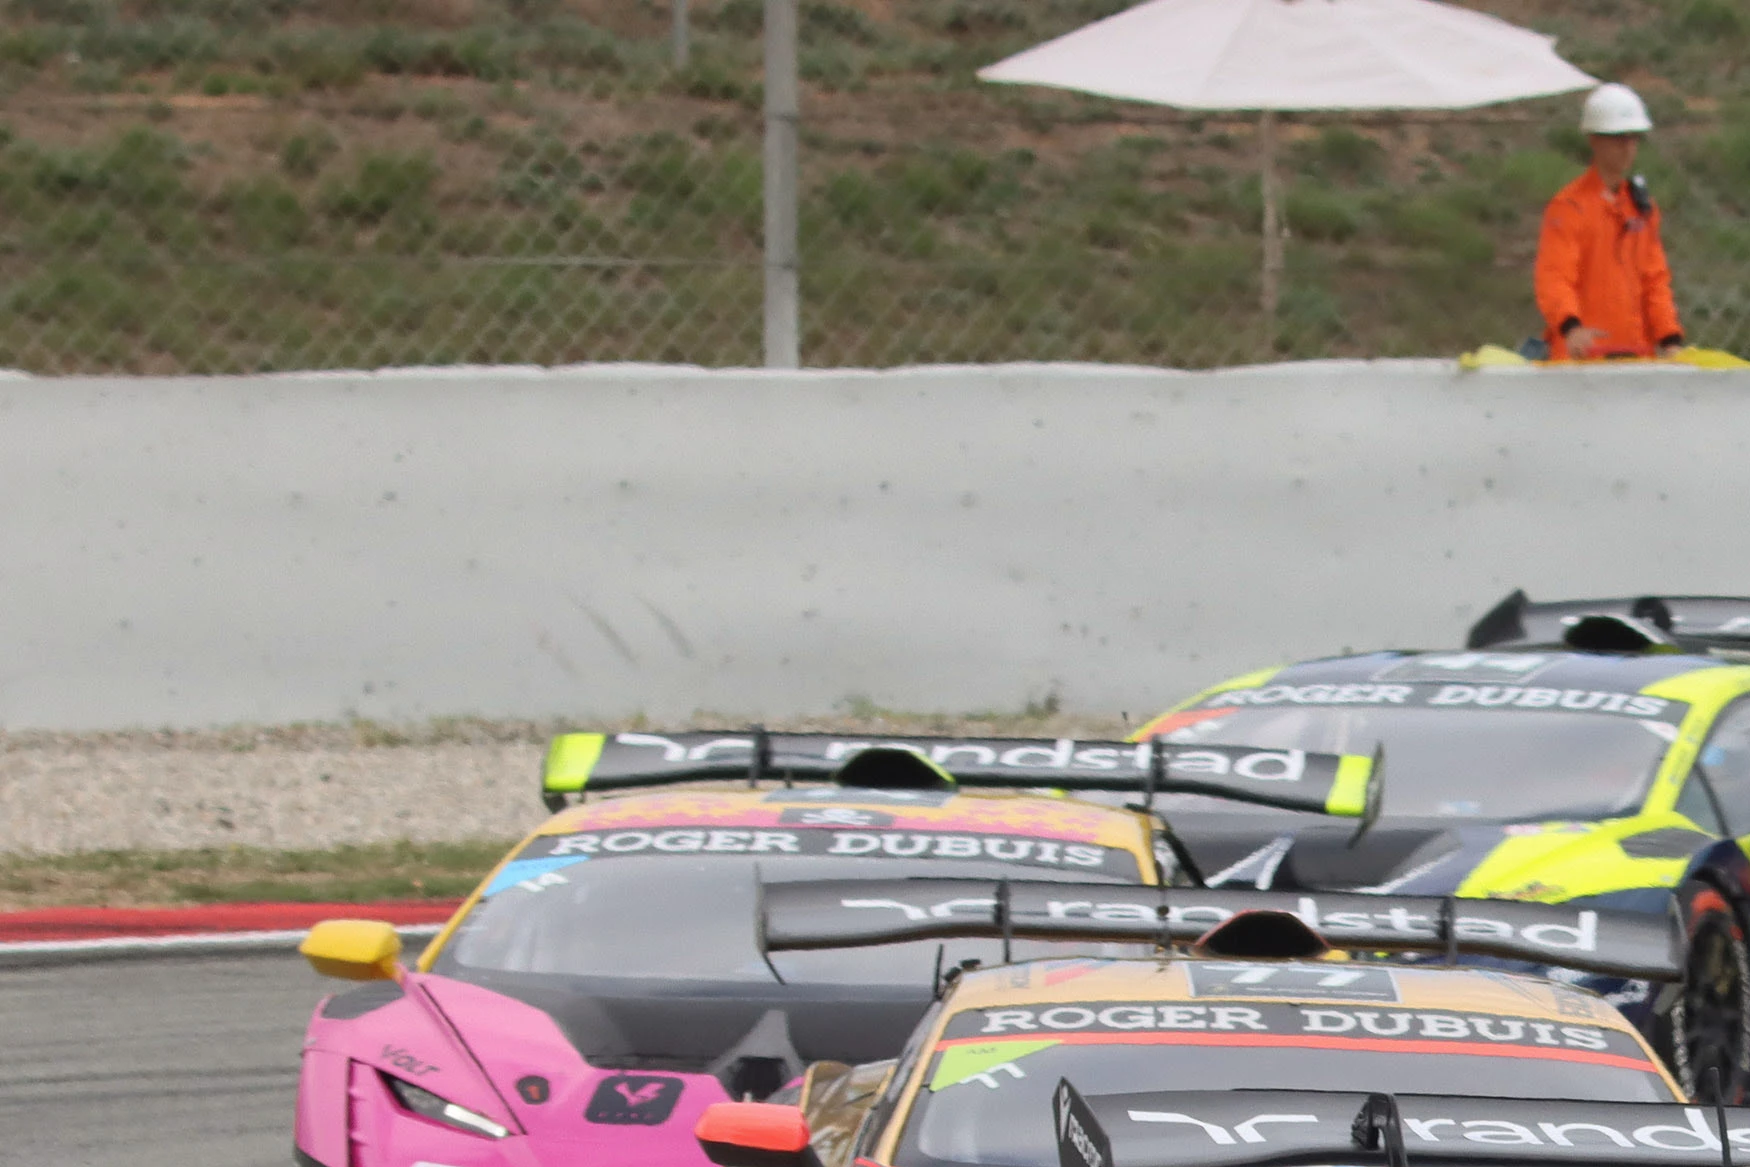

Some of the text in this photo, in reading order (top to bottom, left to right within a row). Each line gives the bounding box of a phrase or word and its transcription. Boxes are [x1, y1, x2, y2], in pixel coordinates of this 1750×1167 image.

[1210, 684, 1669, 716] ROGER DUBUIS
[826, 739, 1307, 782] rndstad
[549, 830, 1105, 867] ROGER DUBUIS
[1202, 965, 1367, 987] 77
[980, 1005, 1608, 1051] ROGER DUBUIS
